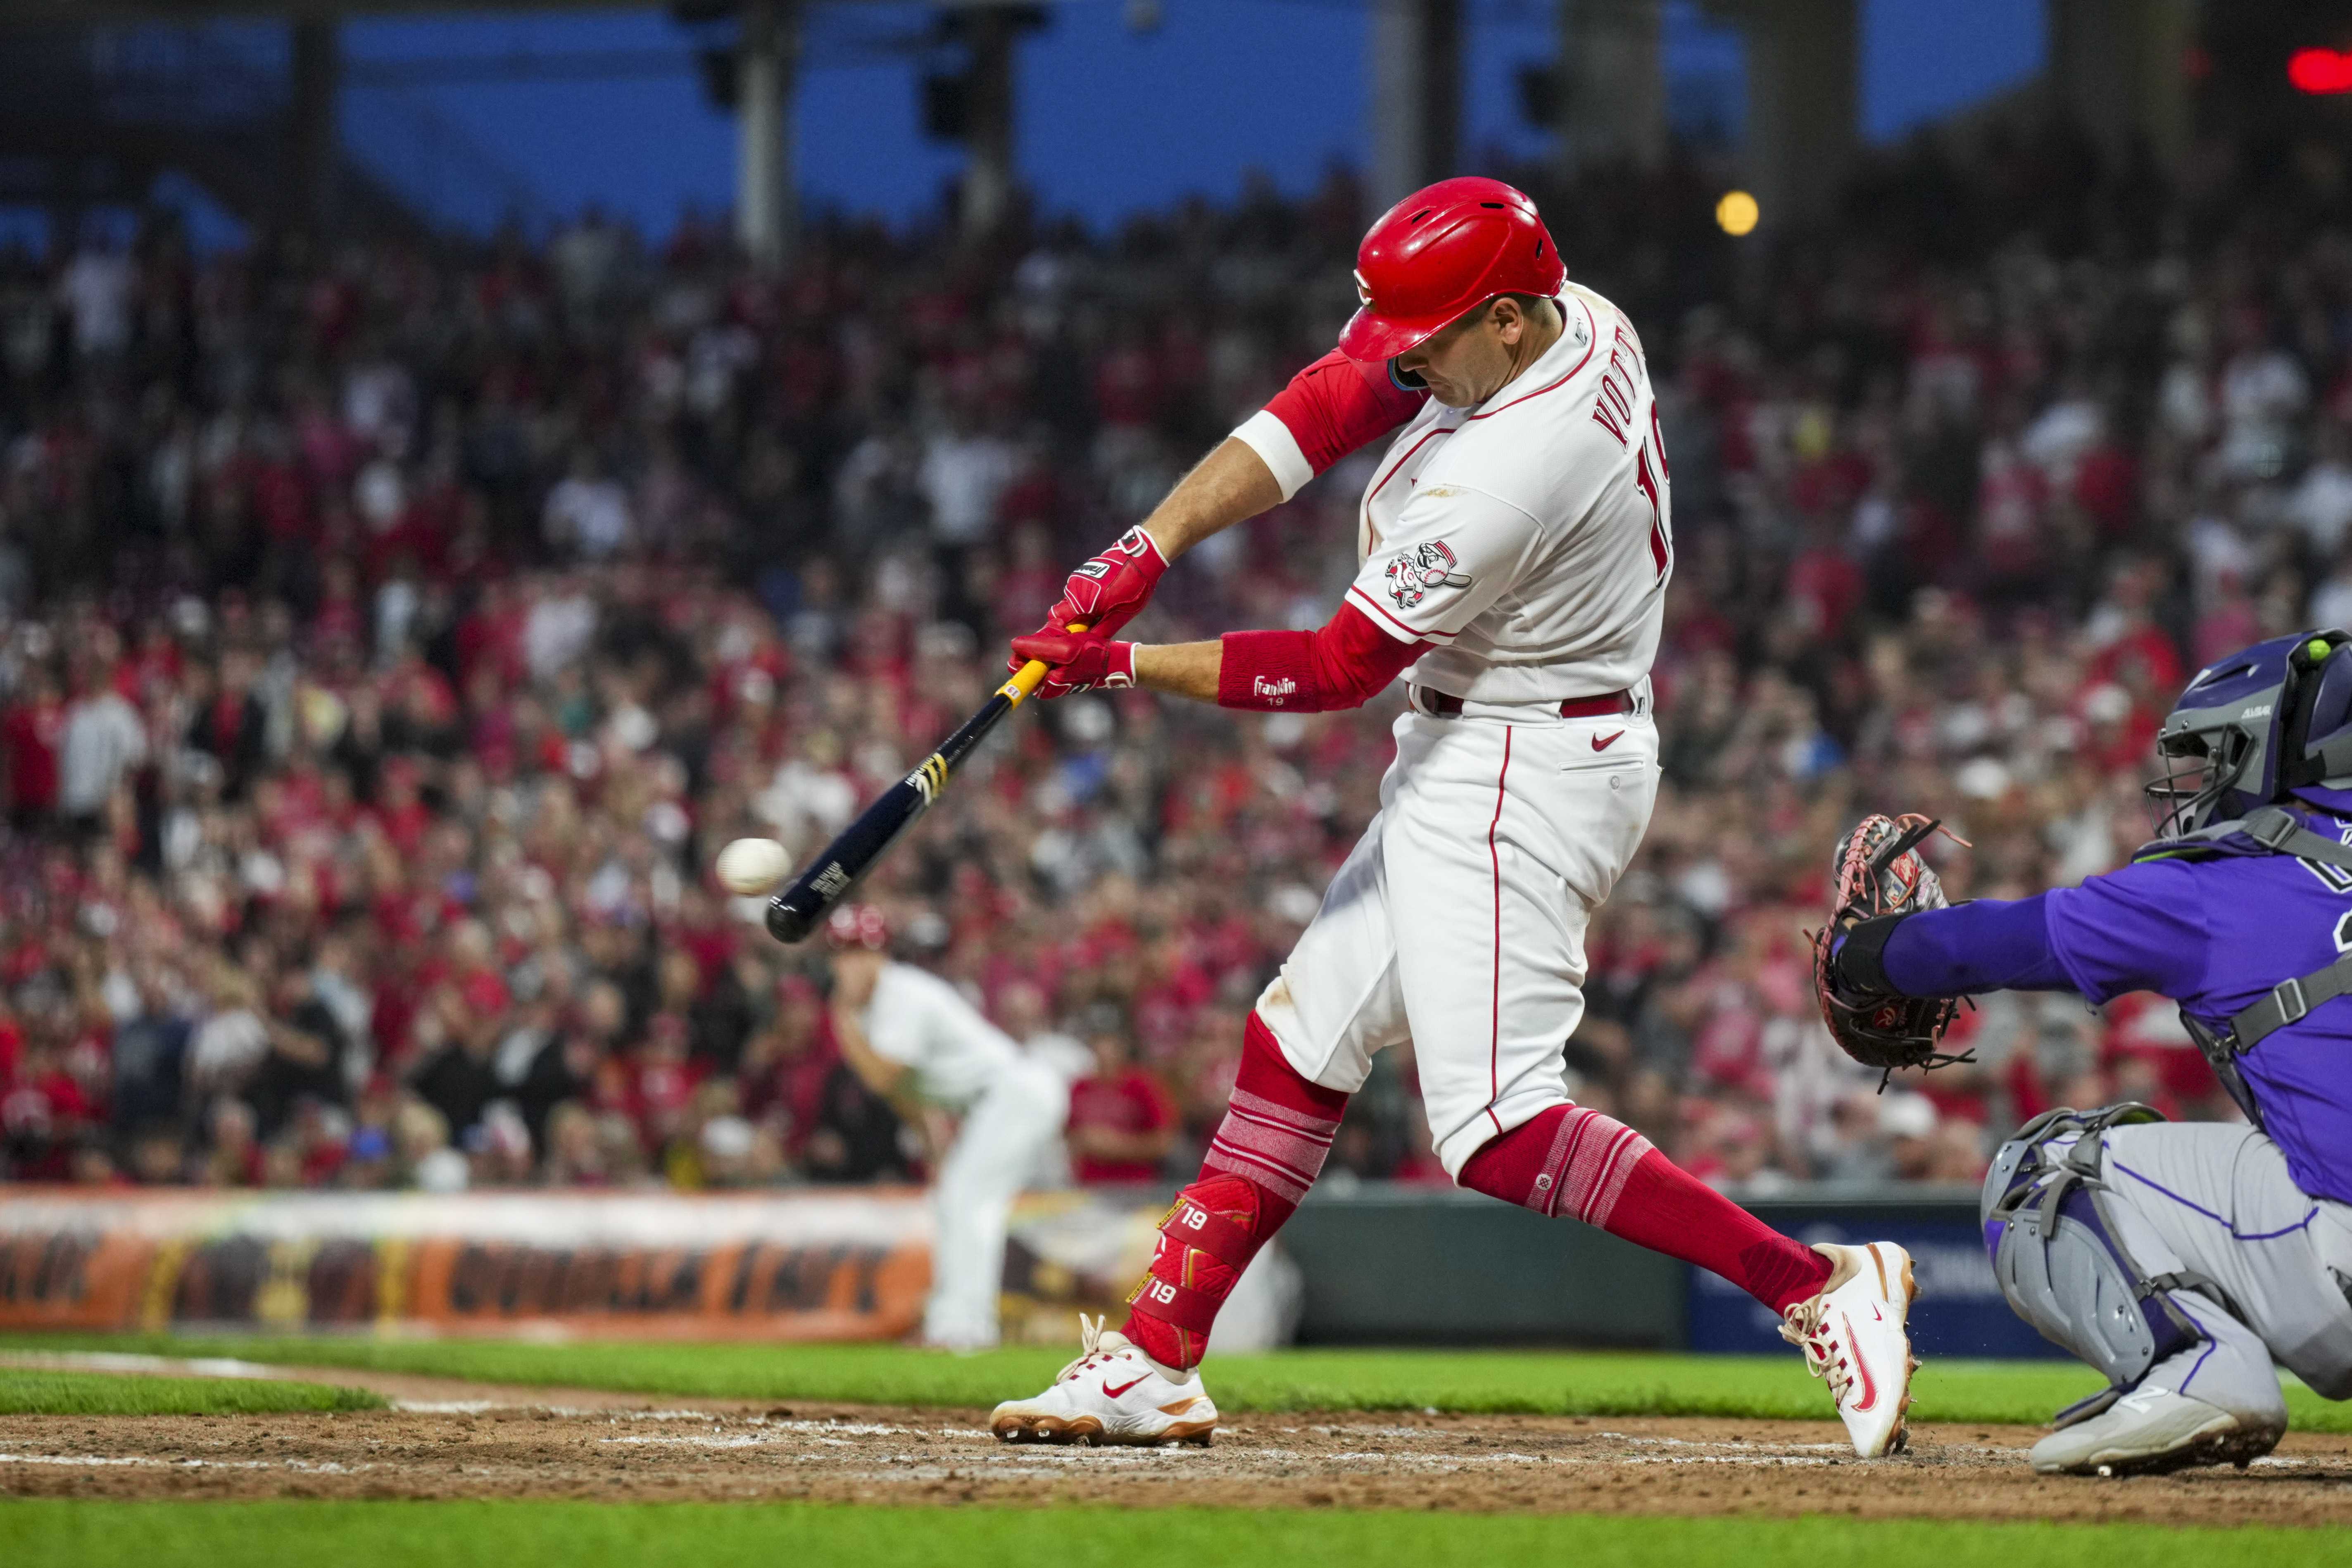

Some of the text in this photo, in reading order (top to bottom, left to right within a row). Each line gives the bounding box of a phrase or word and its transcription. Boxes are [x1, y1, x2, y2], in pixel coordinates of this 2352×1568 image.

[1267, 697, 1284, 706] 19
[1182, 1206, 1208, 1230] 19
[1150, 1280, 1177, 1304] 19
